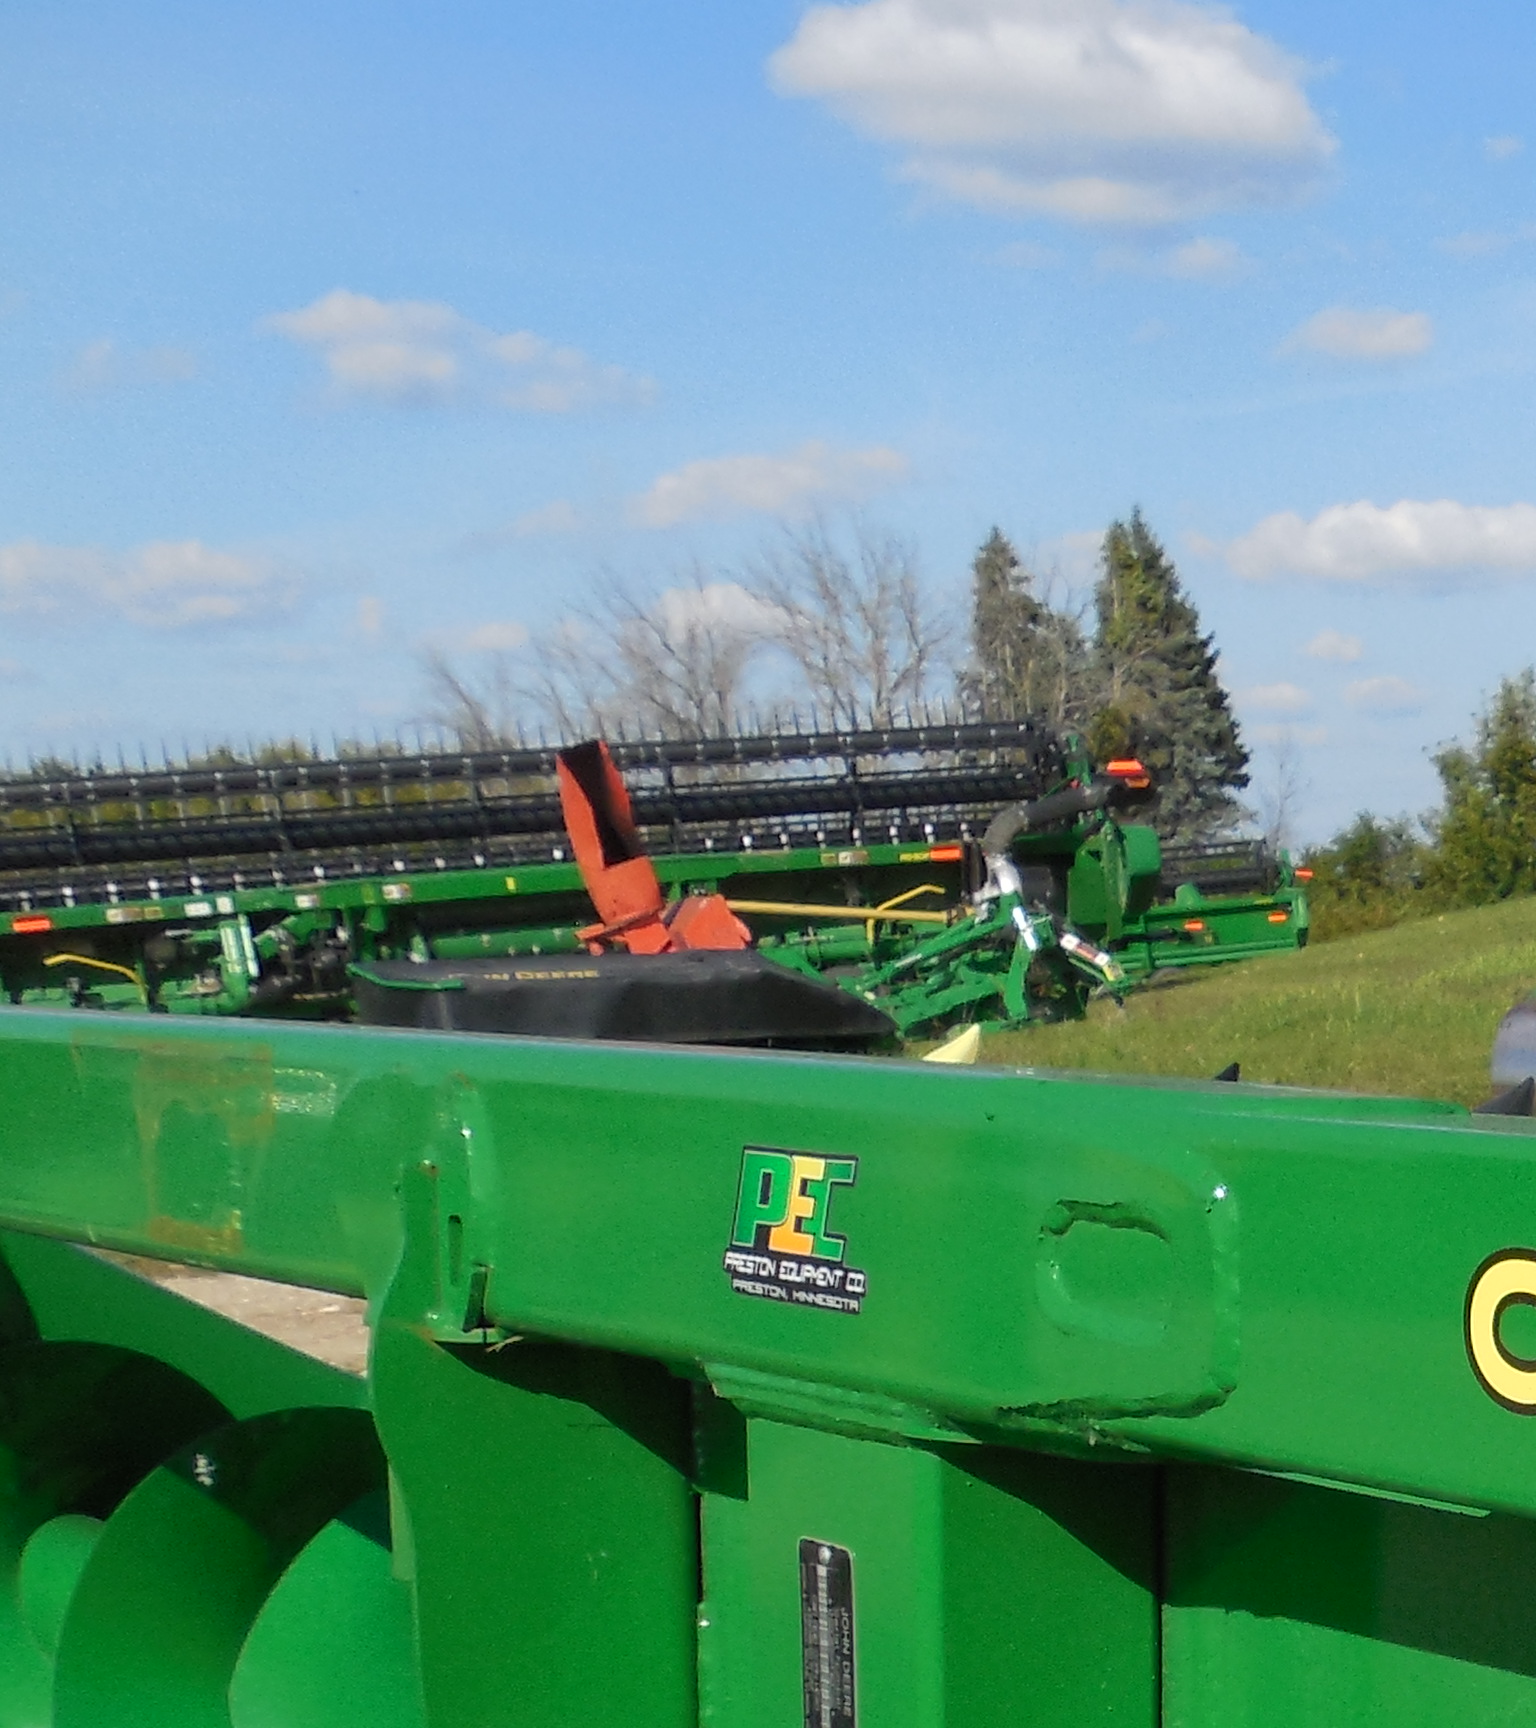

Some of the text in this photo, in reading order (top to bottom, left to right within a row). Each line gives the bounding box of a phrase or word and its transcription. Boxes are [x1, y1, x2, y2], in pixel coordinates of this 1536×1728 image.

[724, 1251, 777, 1277] PRESTON
[778, 1260, 844, 1289] EQUIPMENT
[792, 1290, 860, 1313] MINNESOTA
[840, 1606, 851, 1655] JOHN
